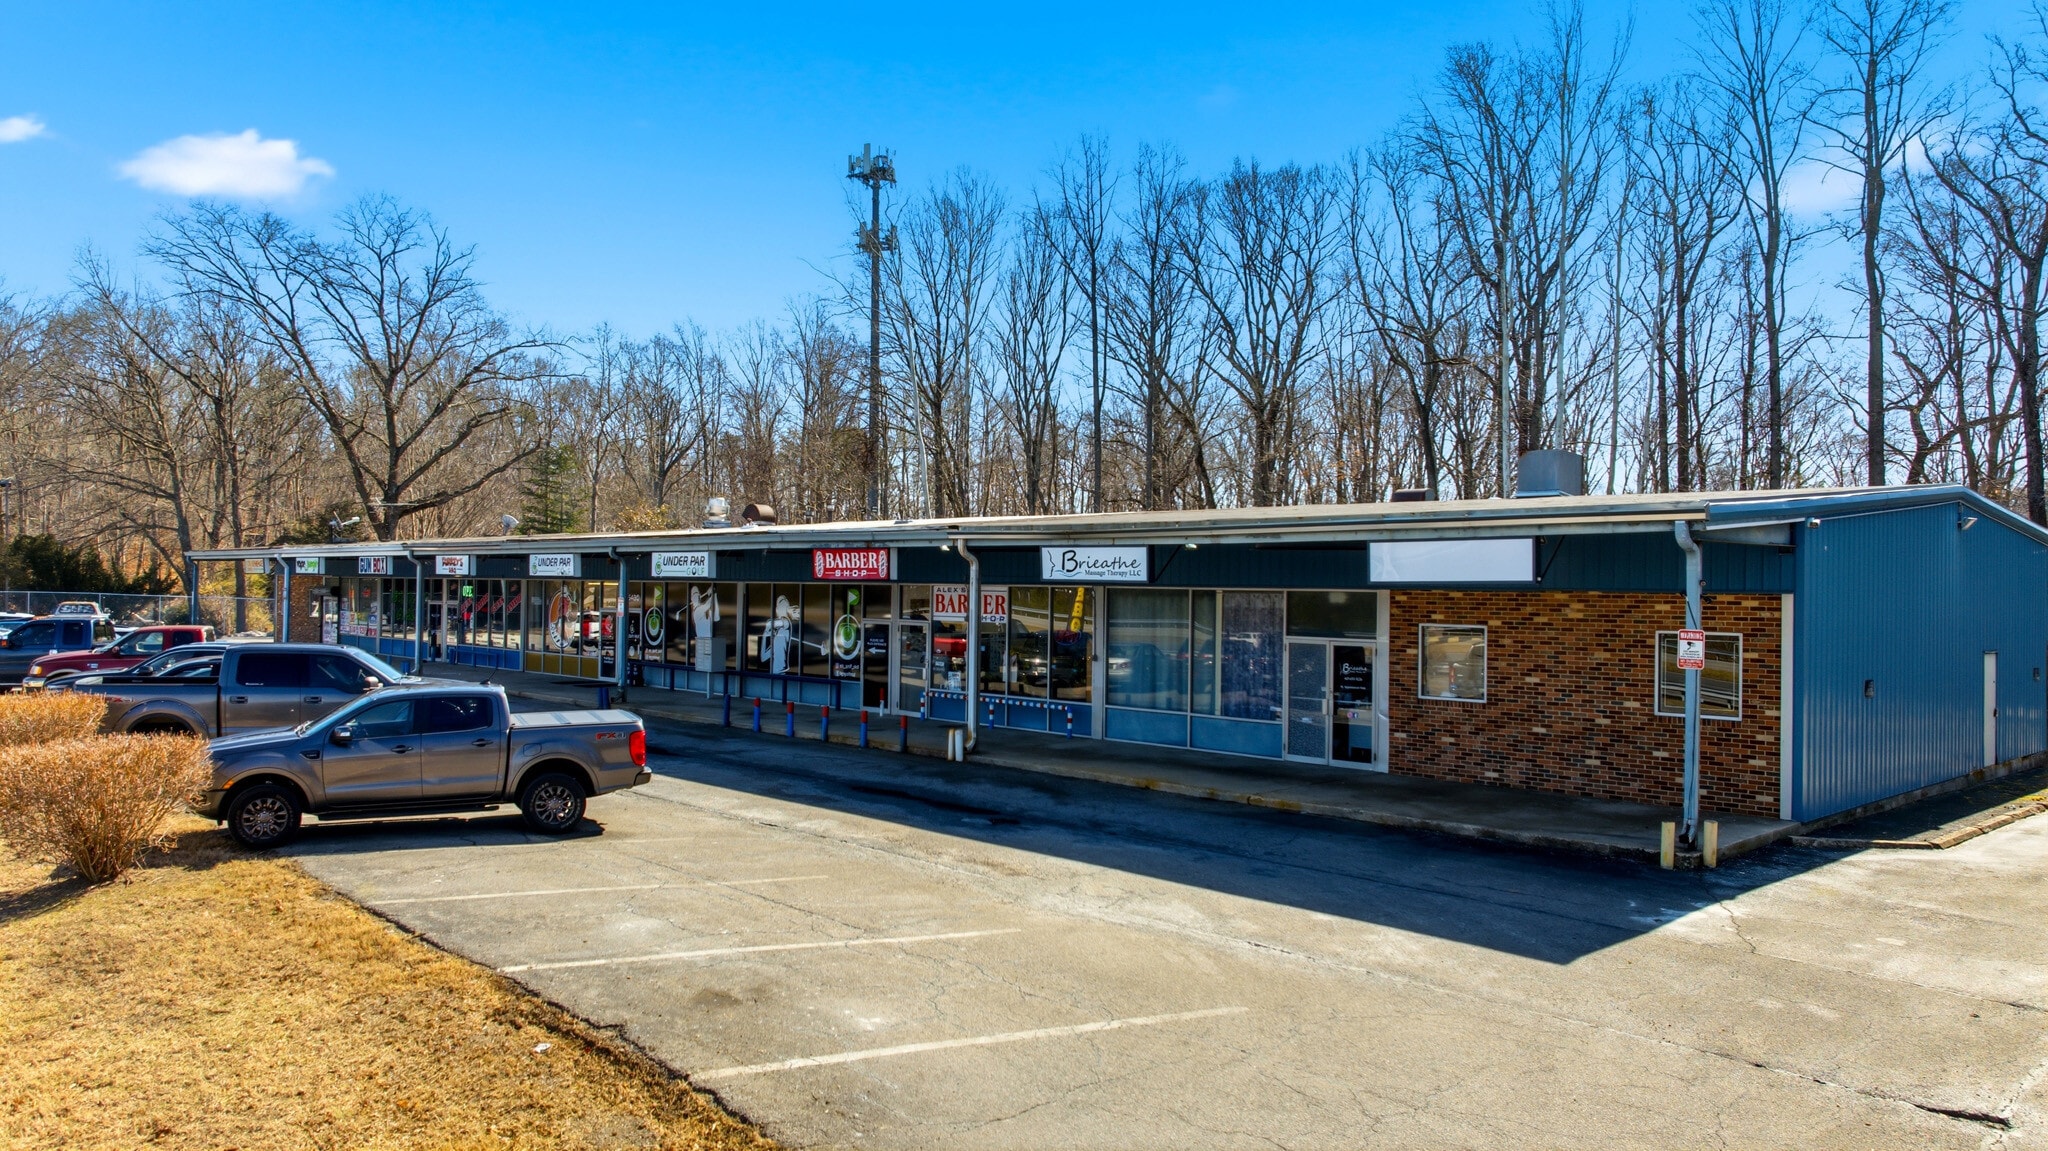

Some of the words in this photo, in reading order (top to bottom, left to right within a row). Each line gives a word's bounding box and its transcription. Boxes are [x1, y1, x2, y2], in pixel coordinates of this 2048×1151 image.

[360, 558, 371, 573] GUN
[373, 558, 385, 573] BOX
[538, 557, 558, 567] UNDER
[559, 557, 571, 567] PAR
[663, 556, 688, 566] UNDER
[690, 556, 705, 566] PAR
[825, 552, 878, 568] BARBER
[1062, 550, 1141, 572] Brieathe
[687, 567, 704, 575] GOLF
[935, 594, 1006, 615] BARER
